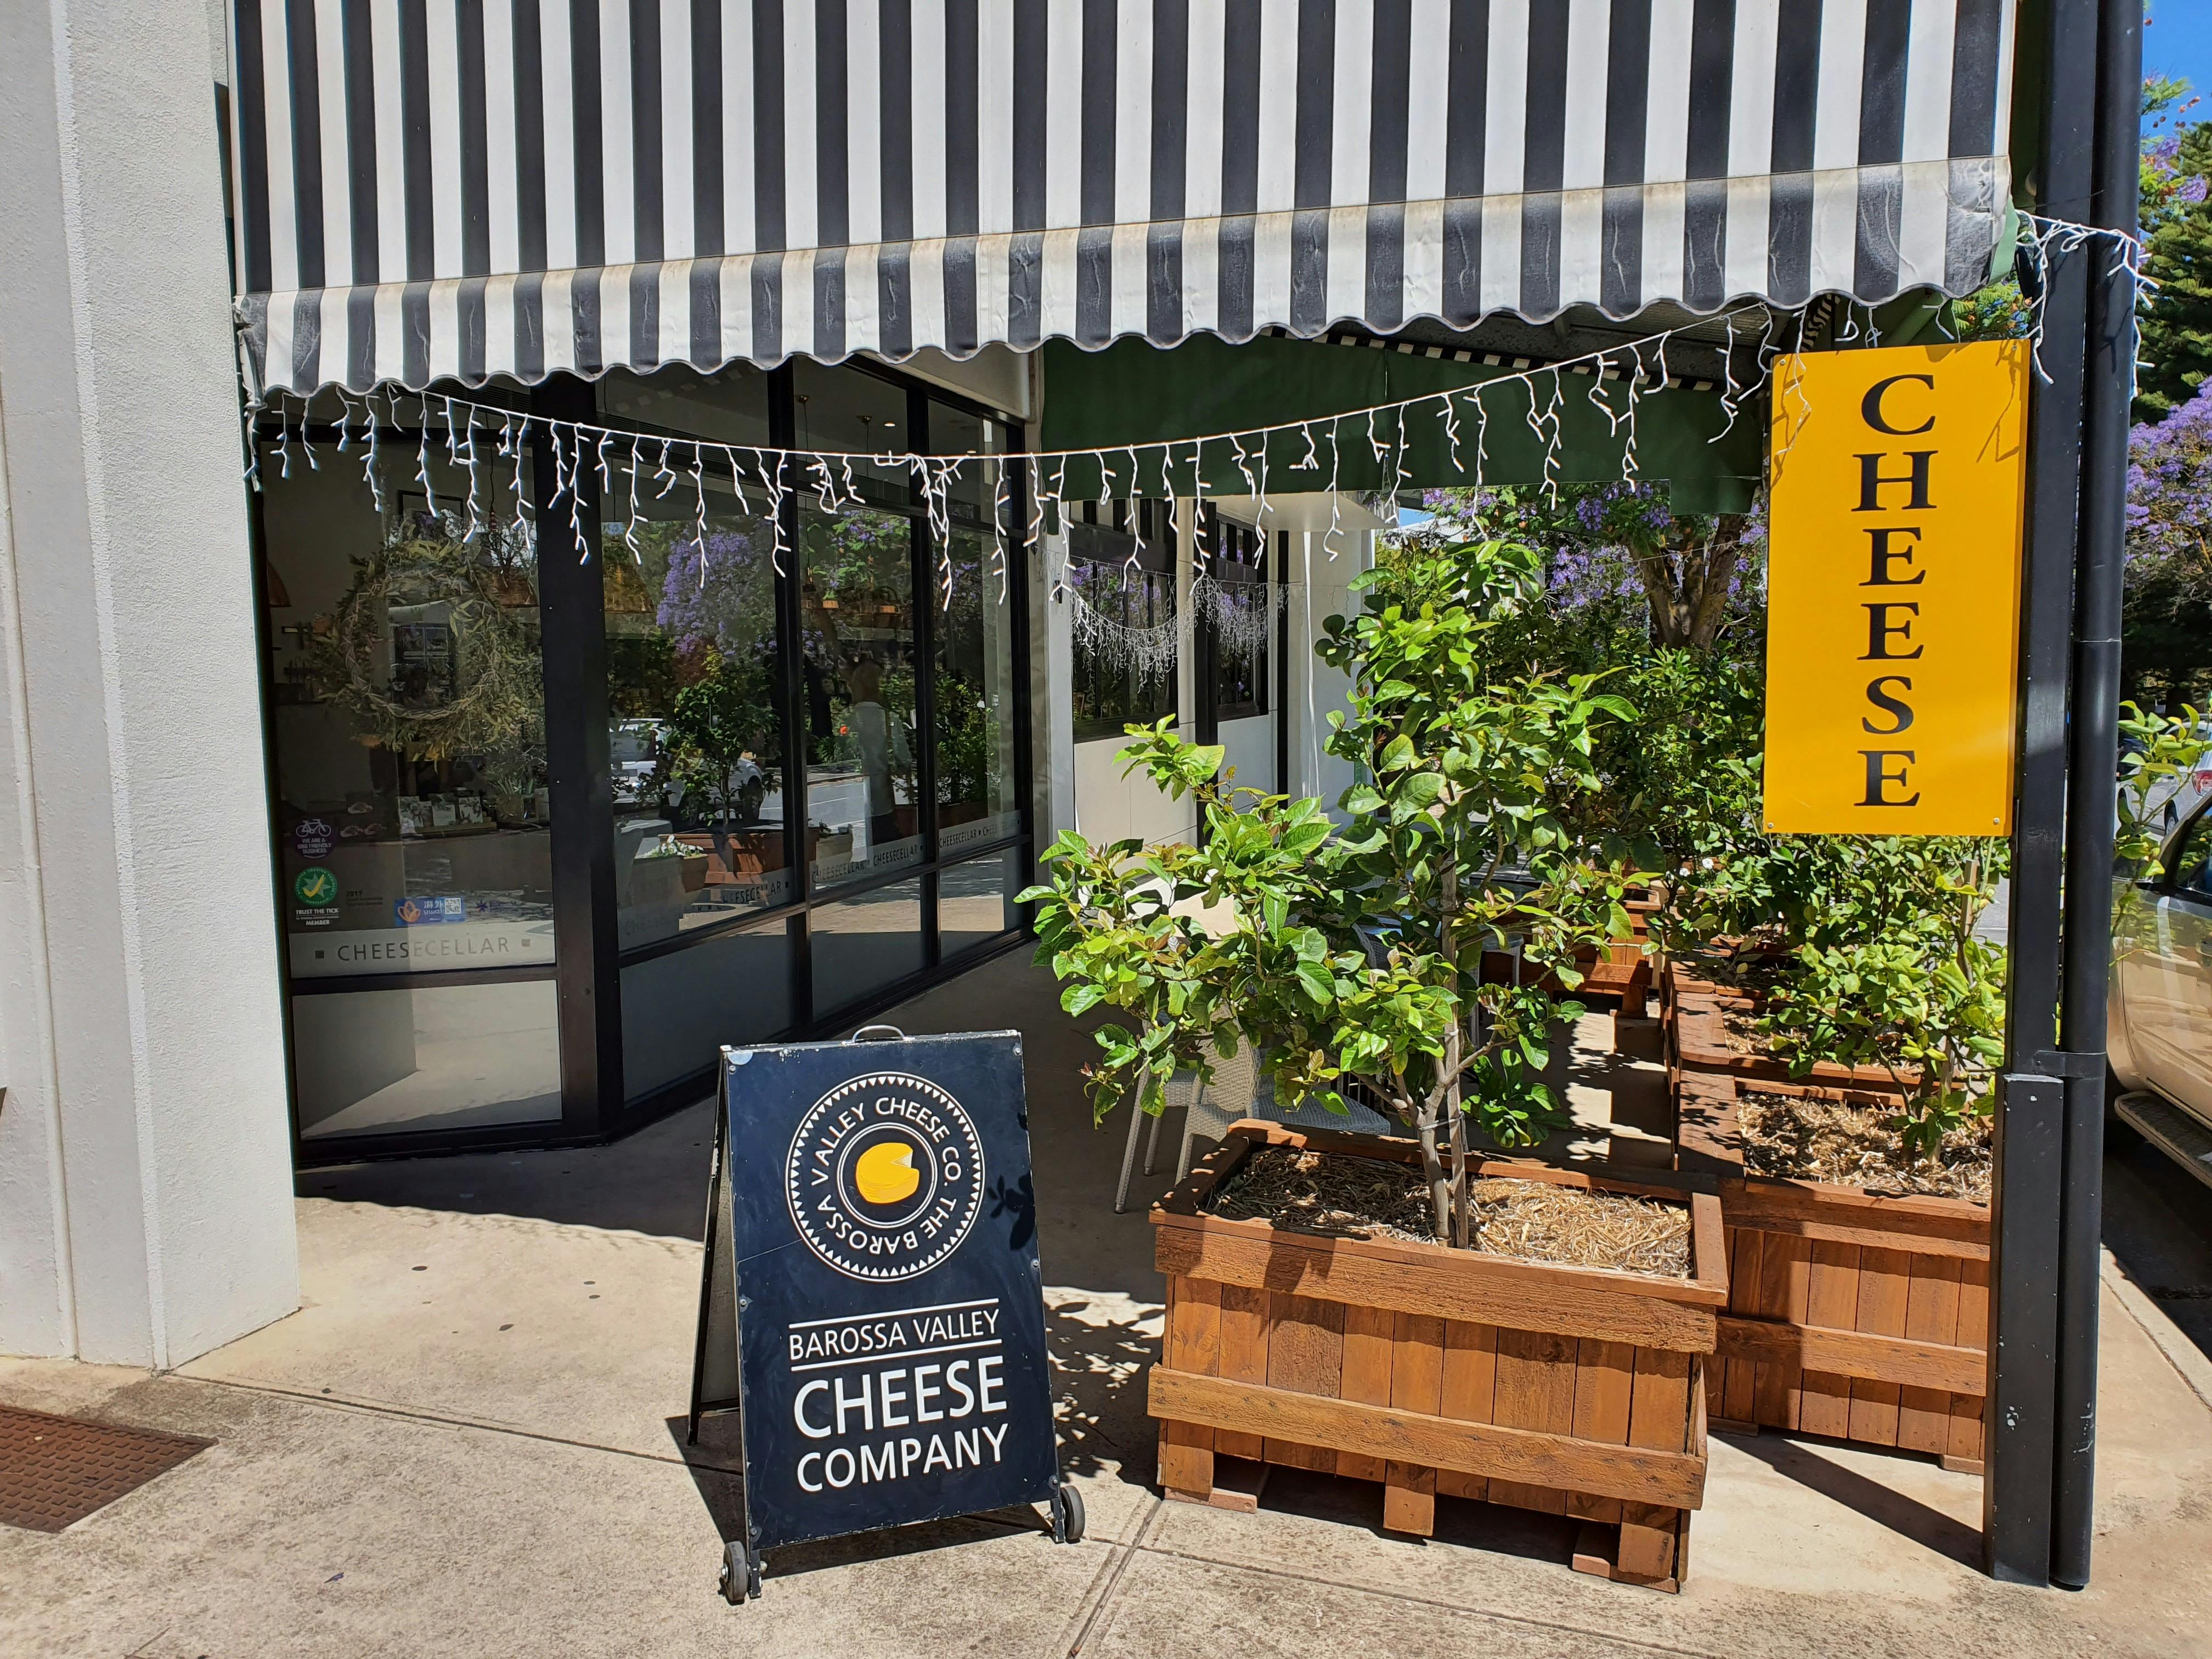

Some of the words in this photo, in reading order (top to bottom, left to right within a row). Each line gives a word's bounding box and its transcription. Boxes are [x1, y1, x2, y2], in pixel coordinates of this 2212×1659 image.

[1850, 374, 1938, 807] CHEESE
[873, 844, 918, 866] CHEESECELLAR
[939, 829, 977, 848] CHEESECELLAR
[338, 936, 509, 962] CHEESECELLAR
[811, 1102, 865, 1186] VALLEY
[875, 1097, 950, 1144] CHEESE
[941, 1146, 962, 1187] CO.
[817, 1194, 918, 1255] BAROSSA
[924, 1197, 957, 1239] THE
[789, 1321, 907, 1361] BAROSSA
[912, 1308, 1000, 1344] VALLEY
[793, 1355, 1008, 1439] CHEESE
[797, 1423, 1008, 1493] COMPANY
